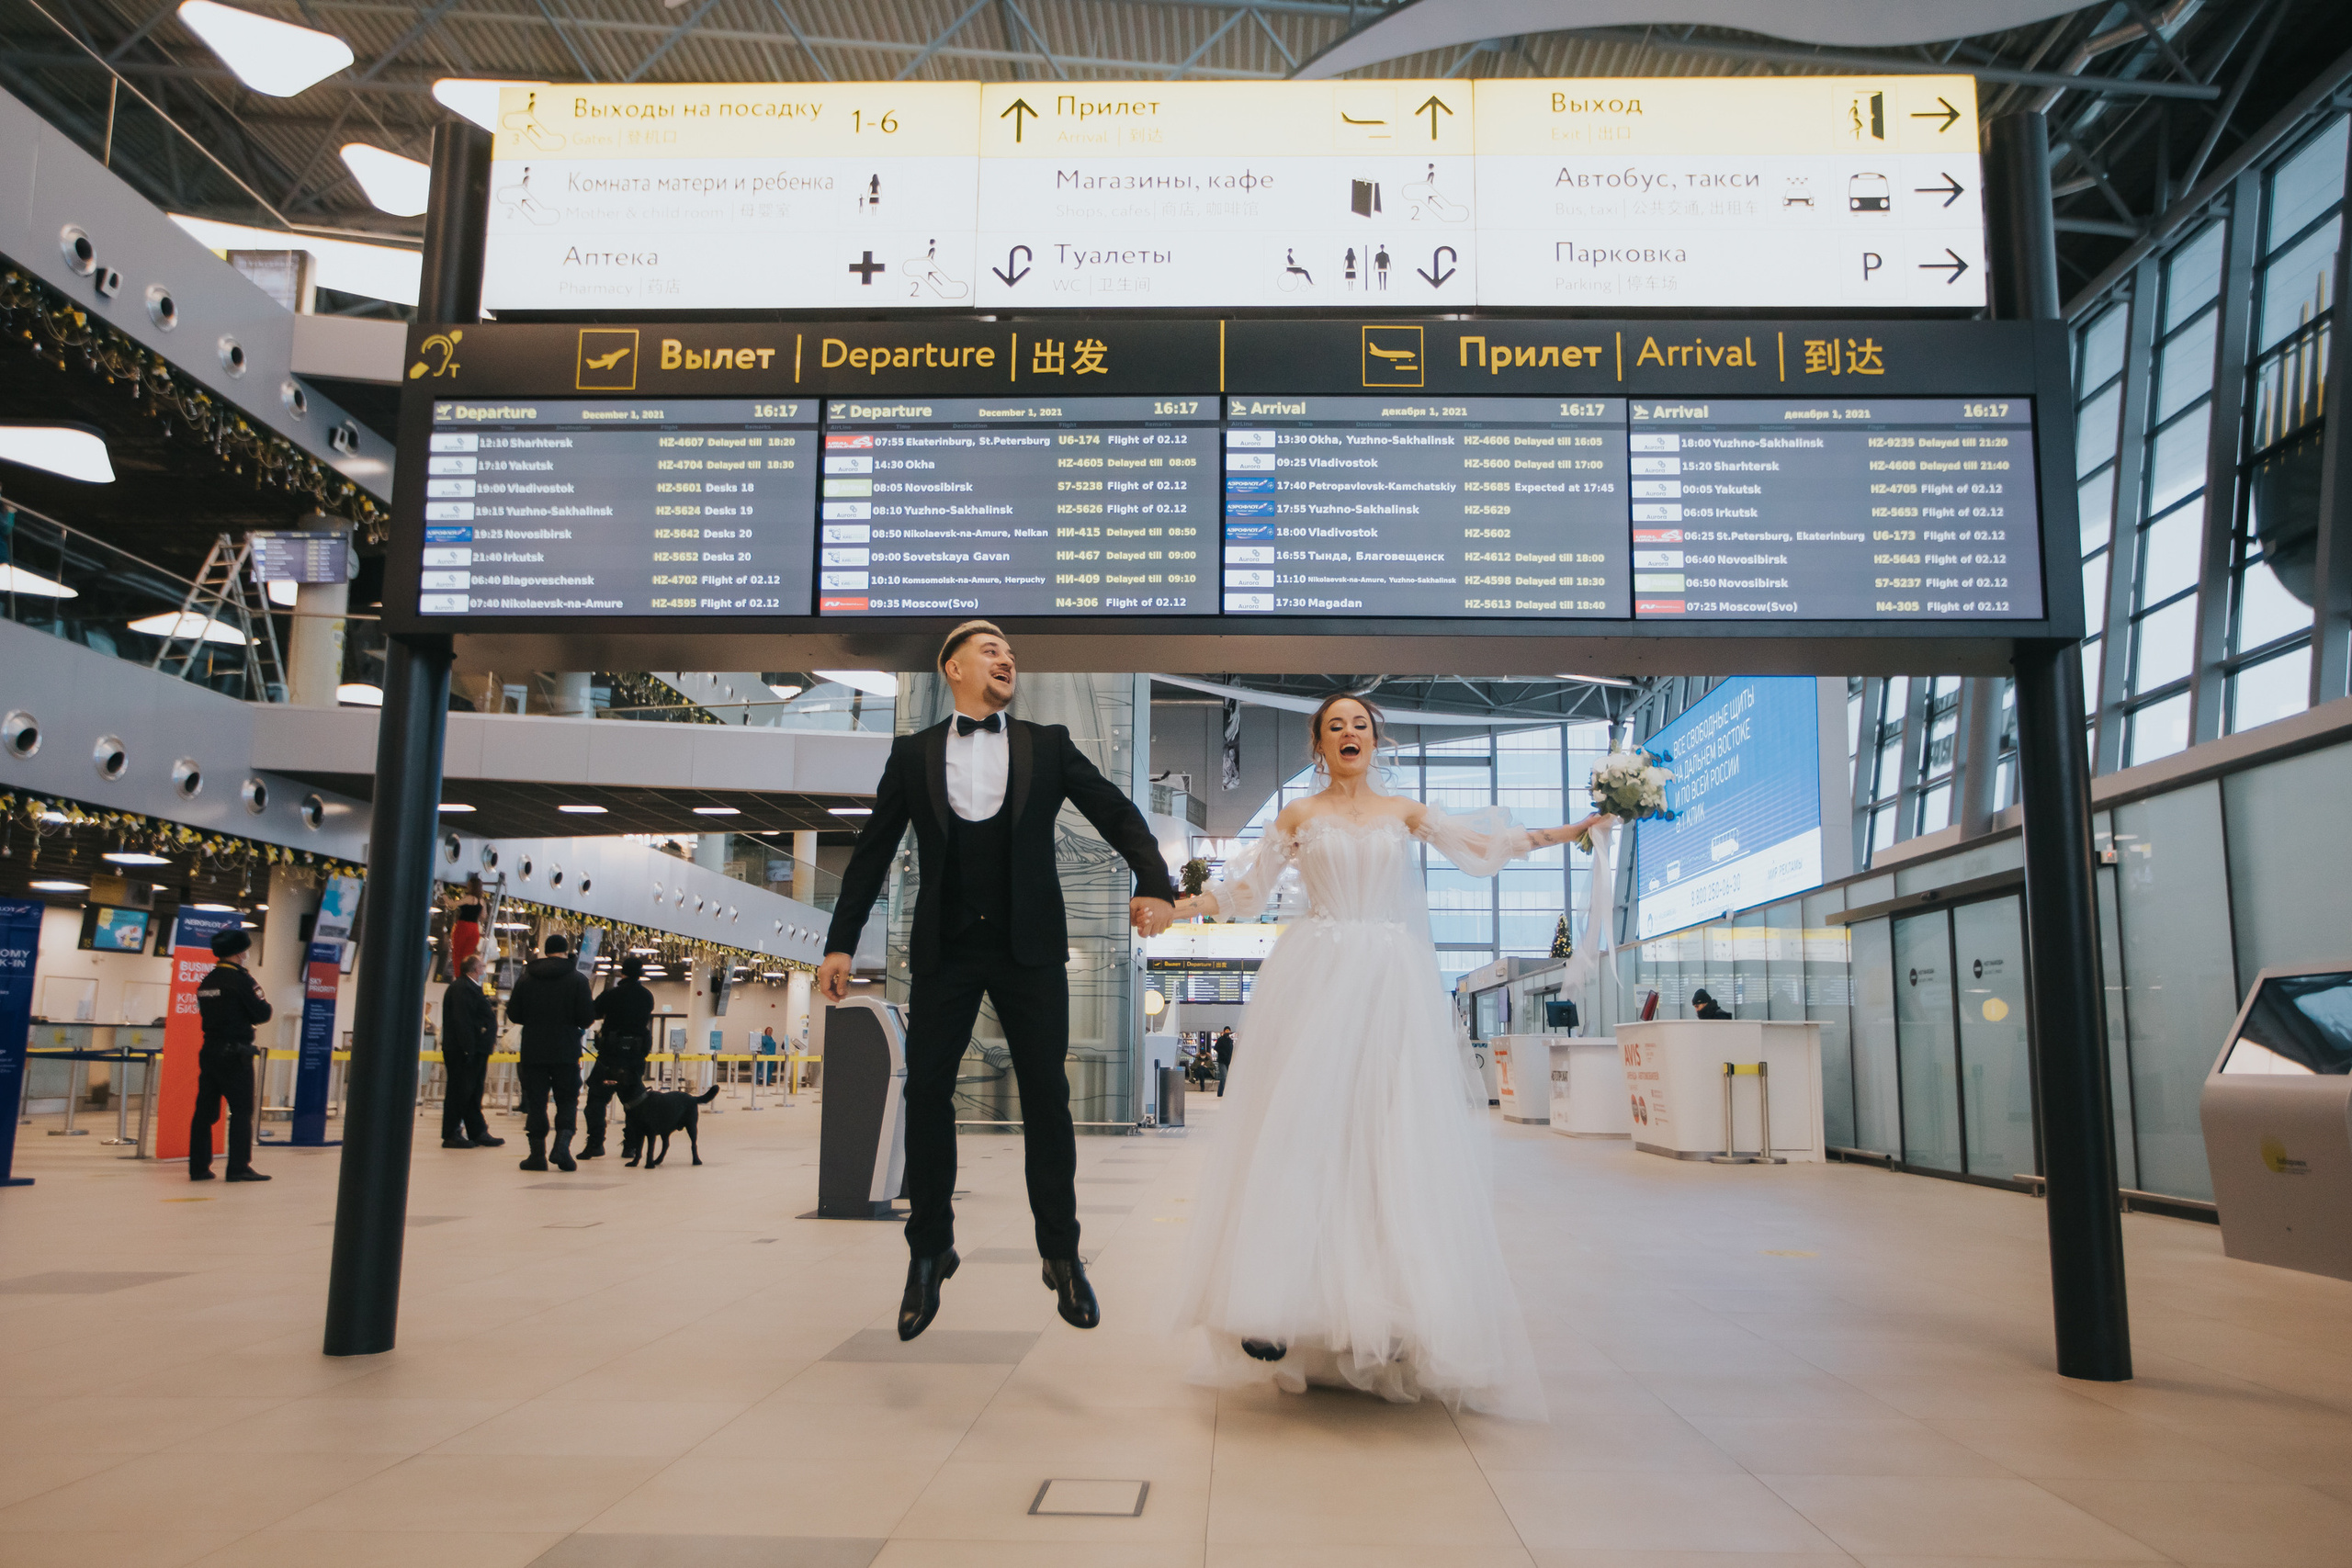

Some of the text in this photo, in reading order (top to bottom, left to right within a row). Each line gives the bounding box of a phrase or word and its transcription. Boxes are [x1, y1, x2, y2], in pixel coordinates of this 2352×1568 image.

[574, 97, 823, 121] Выходы на посадку
[1057, 96, 1161, 120] Прилет
[1551, 92, 1643, 116] Выход
[851, 108, 899, 134] 1-6
[572, 133, 614, 145] Gates
[1057, 130, 1108, 144] Arrival
[1129, 128, 1163, 143] 到达
[1551, 127, 1580, 141] Exit
[1598, 125, 1631, 141] 出口
[568, 171, 834, 197] Комната матери и ребенка
[1057, 168, 1274, 194] Магазины, кафе
[1555, 166, 1760, 194] Автобус, такси
[1410, 206, 1420, 221] 2
[562, 245, 659, 266] Аптека
[1054, 243, 1171, 270] Туалеты
[1555, 242, 1687, 268] Парковка
[560, 281, 633, 297] Pharmacy
[909, 281, 920, 298] 2
[1053, 278, 1081, 292] WC
[1097, 276, 1151, 293] 卫生间
[1555, 276, 1612, 294] Parking
[1627, 275, 1678, 292] 停车场
[661, 339, 775, 371] Вылет
[821, 338, 996, 374] Departure
[1032, 338, 1110, 376] 出发
[1459, 336, 1602, 377] Прилет
[1635, 336, 1757, 367] Arrival
[1804, 338, 1885, 377] 到达
[455, 406, 537, 421] Departure
[754, 405, 797, 417] 16:17
[850, 405, 932, 420] Departure
[978, 409, 1025, 417] December
[1028, 409, 1036, 417] 1,
[1154, 401, 1198, 414] 16:17
[1251, 402, 1306, 414] Arrival
[1382, 407, 1467, 417] декабря 1, 2021
[1560, 403, 1605, 416] 16:17
[1653, 405, 1709, 418] Arrival
[1784, 410, 1871, 420] декабря 1, 2021
[1963, 404, 2008, 417] 16:17
[582, 411, 664, 420] December 1, 2021
[480, 437, 796, 449] 12:10 Sharhtersk HZ-4607 Delayed till 18:20
[875, 435, 1187, 447] 07:55 Ekaterinburg, St.Petersburg U6-174 Flight of 02.12
[1277, 481, 1306, 491] 17:40
[1309, 481, 1456, 492] Petropavlovsk-Kamchatskiy
[1464, 482, 1510, 491] HZ-5685
[1515, 483, 1565, 493] Expected
[1584, 483, 1614, 492] 17:45
[1682, 484, 2003, 495] 00:05 Yakutsk HZ-4705 Flight of 02.12
[873, 504, 1187, 515] 08:10 Yuzhno-Sakhalinsk HZ-5626 Flight of 02.12
[1277, 504, 1510, 514] 17:55 Yuzhno-Sakhalinsk HZ-5629
[1276, 551, 1306, 560] 16:55
[1308, 551, 1351, 562] Тында,
[1356, 551, 1444, 562] Благовещенск
[1464, 552, 1510, 561] HZ-4612
[1515, 553, 1556, 563] Delayed
[1576, 554, 1604, 562] 18:00
[870, 598, 1186, 609] 09:35 Moscow(Svo) N4-306 Flight of 02.12
[1673, 684, 1755, 760] ВСЕ СВОБОДНЫЕ ЩИТЫ
[1684, 742, 1716, 784] ДАЛЬНЕМ
[1717, 717, 1751, 758] ВОСТОКЕ
[1675, 754, 1739, 809] И ПО ВСЕЙ РОССИИ
[1686, 801, 1705, 829] КЛИК
[1696, 886, 1707, 906] 800
[179, 961, 217, 973] BUSINE
[179, 972, 205, 983] CLAS
[177, 993, 198, 1003] КЛА
[175, 1004, 199, 1014] БИЗ
[1624, 1043, 1642, 1066] AVIS
